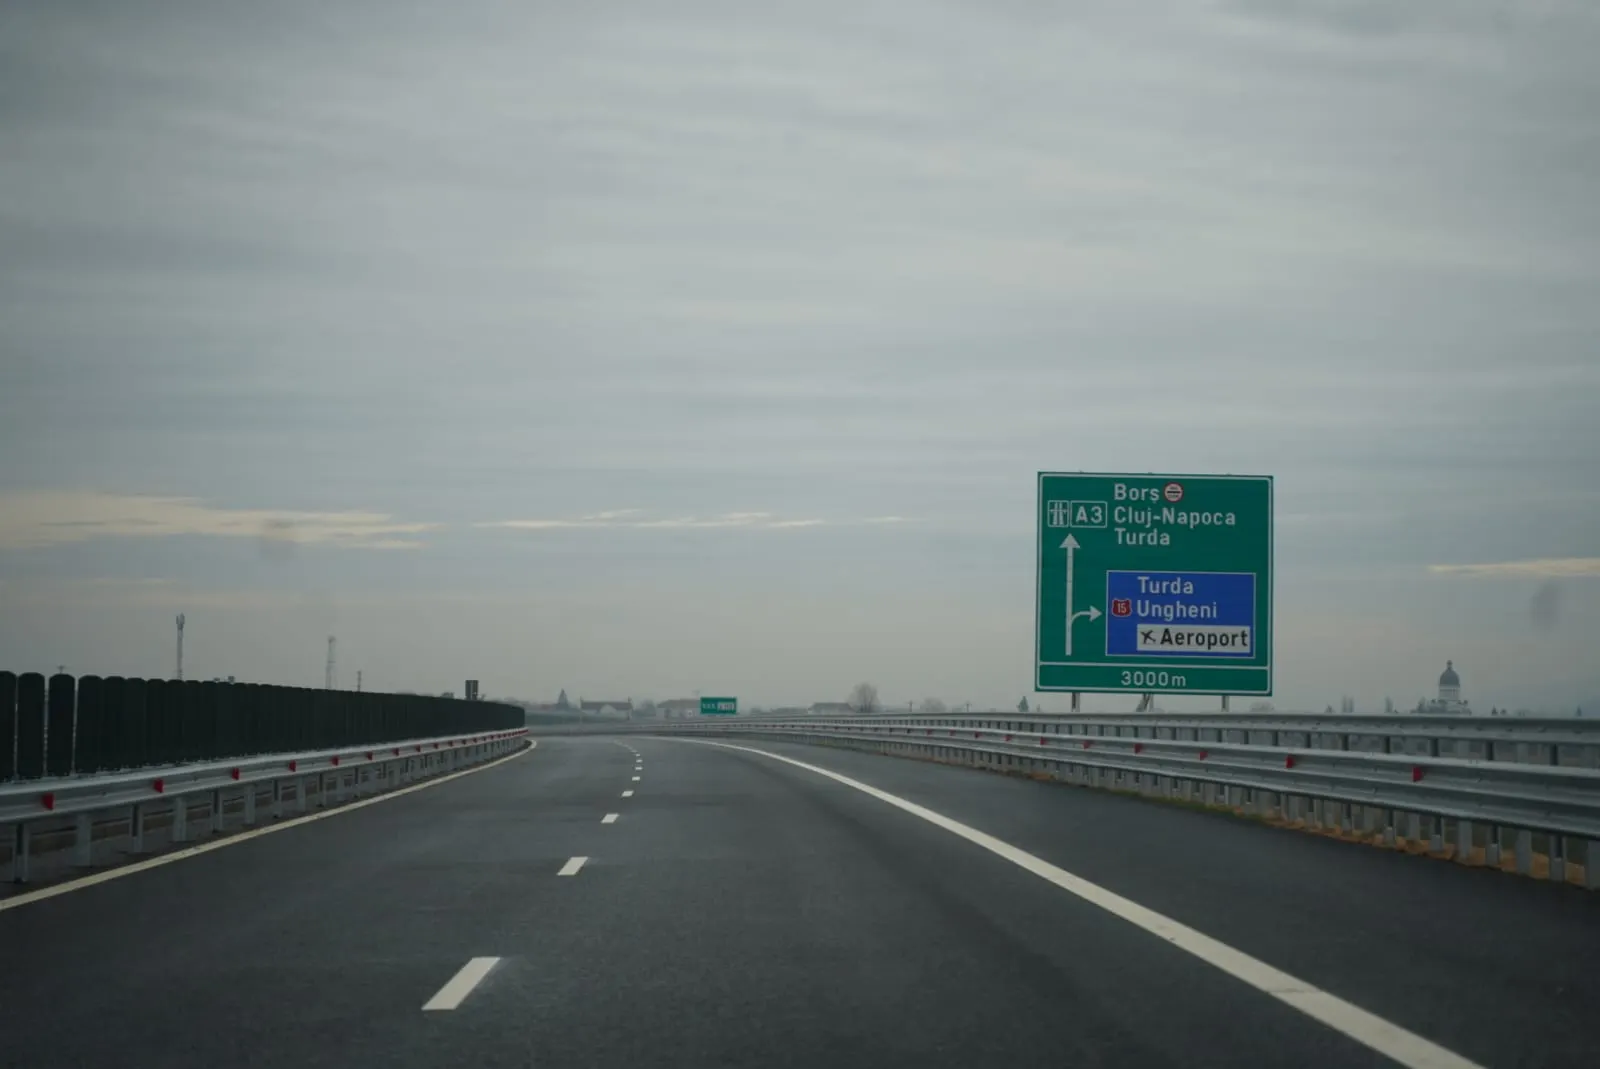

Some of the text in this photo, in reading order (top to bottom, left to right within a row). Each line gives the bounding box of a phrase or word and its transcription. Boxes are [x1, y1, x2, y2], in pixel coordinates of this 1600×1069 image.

[1075, 506, 1103, 523] A3
[1114, 506, 1236, 528] Cluj-Napoca
[1115, 528, 1170, 545] Turda
[1138, 576, 1194, 594] Turda
[1117, 602, 1127, 614] 15
[1137, 600, 1218, 621] Ungheni
[1160, 628, 1248, 650] Aeroport
